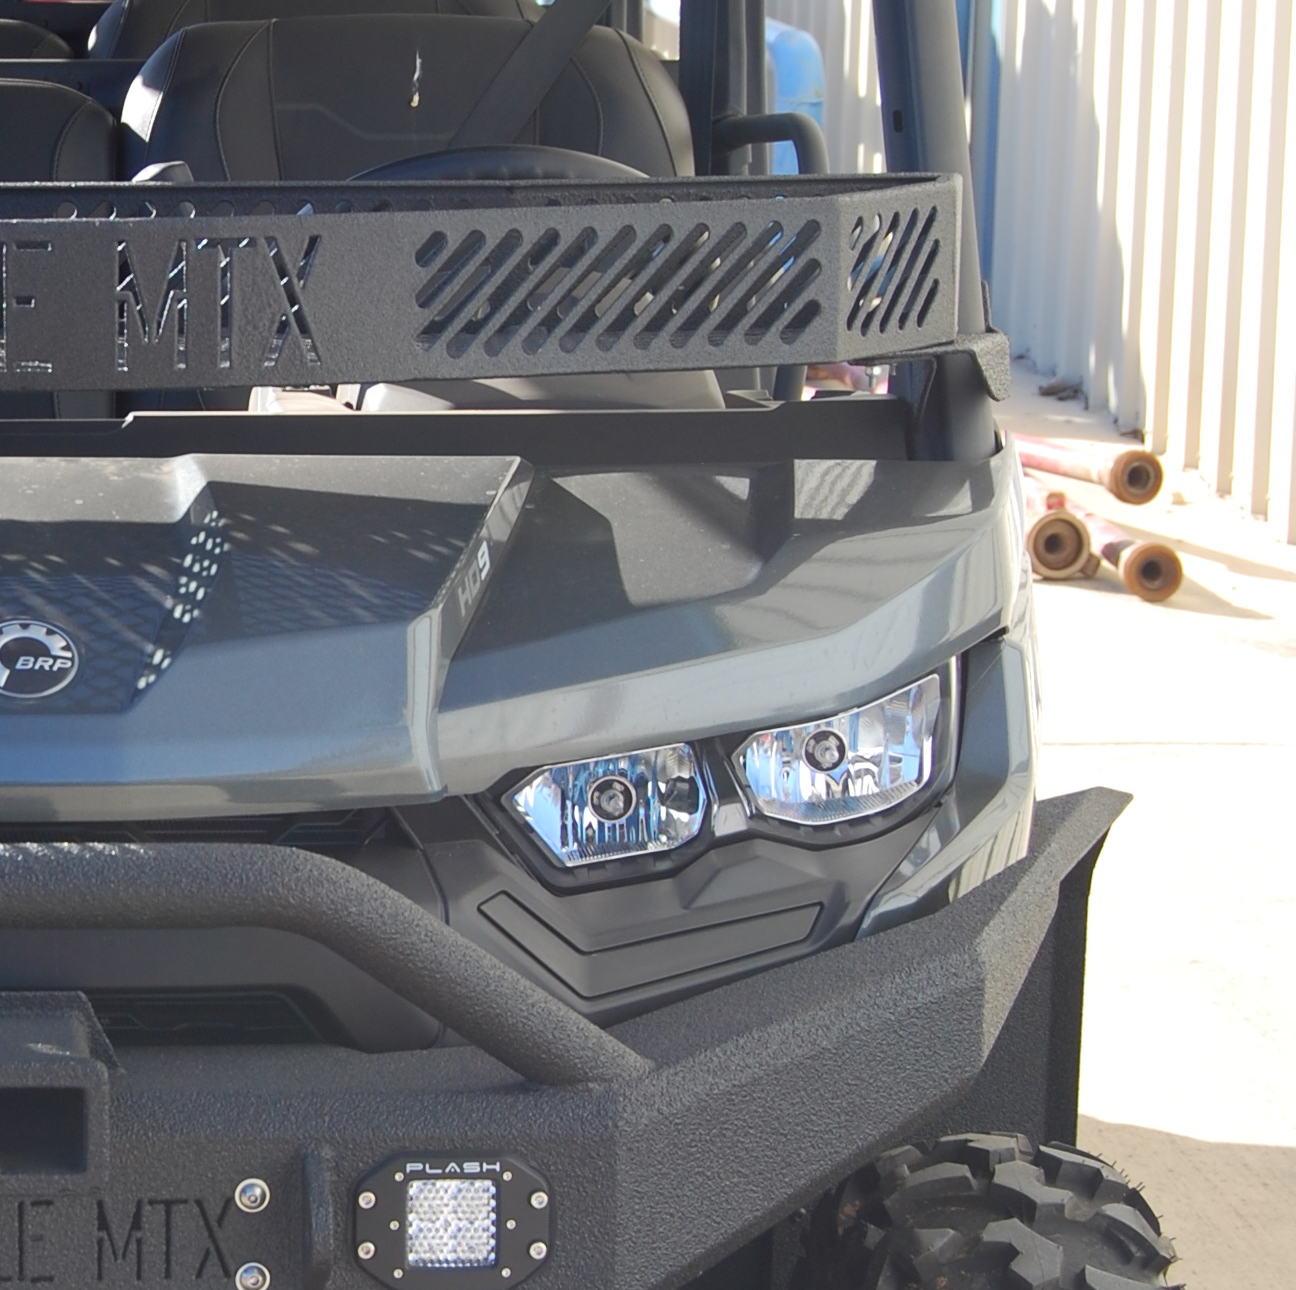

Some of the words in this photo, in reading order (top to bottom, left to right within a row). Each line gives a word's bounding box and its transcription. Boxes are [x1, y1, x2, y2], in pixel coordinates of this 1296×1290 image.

[115, 234, 322, 372] MTX
[15, 656, 73, 672] BRP
[405, 1161, 501, 1174] PLASH
[96, 1198, 235, 1282] MTX
